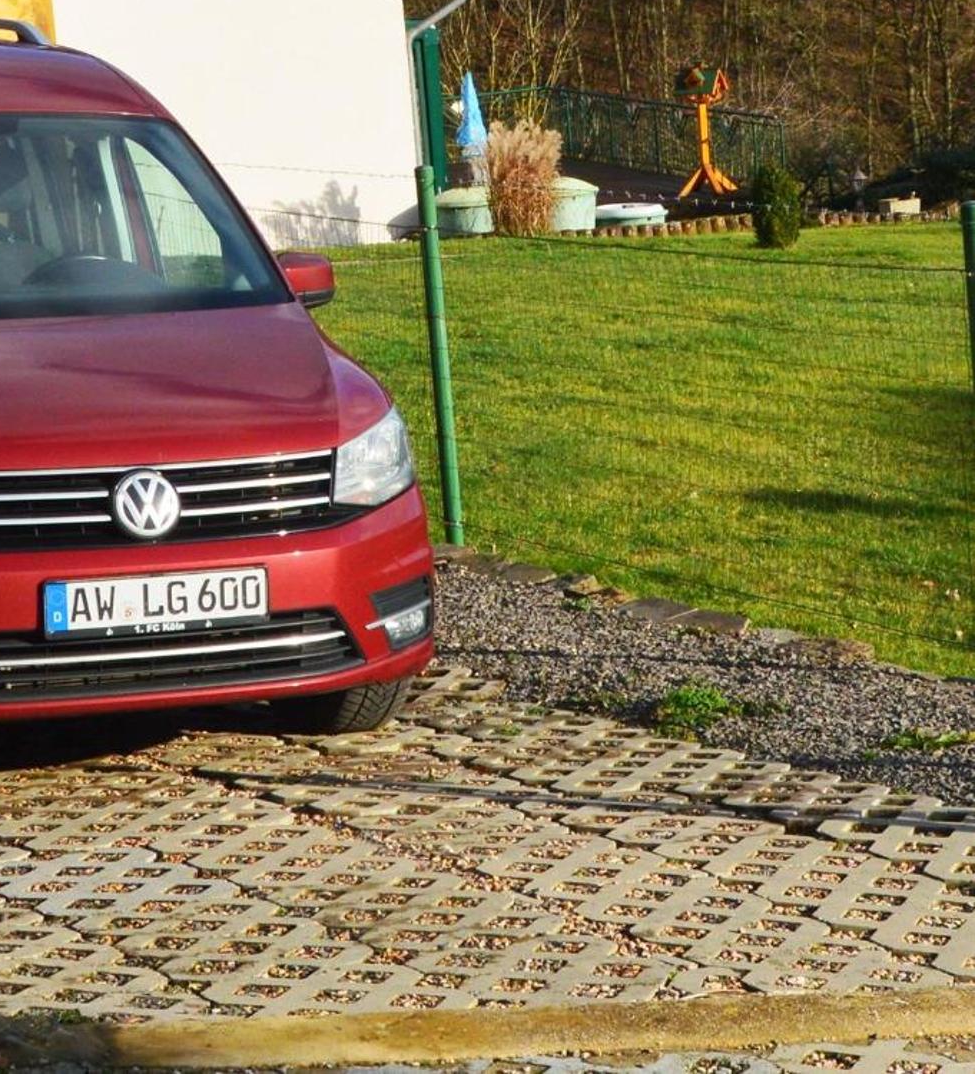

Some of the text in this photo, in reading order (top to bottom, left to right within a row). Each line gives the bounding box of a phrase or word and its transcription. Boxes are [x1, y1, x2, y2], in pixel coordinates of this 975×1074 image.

[117, 472, 177, 535] VW
[71, 576, 261, 623] AW LG 600
[53, 611, 63, 623] D
[134, 621, 186, 634] 1. FC Köln
